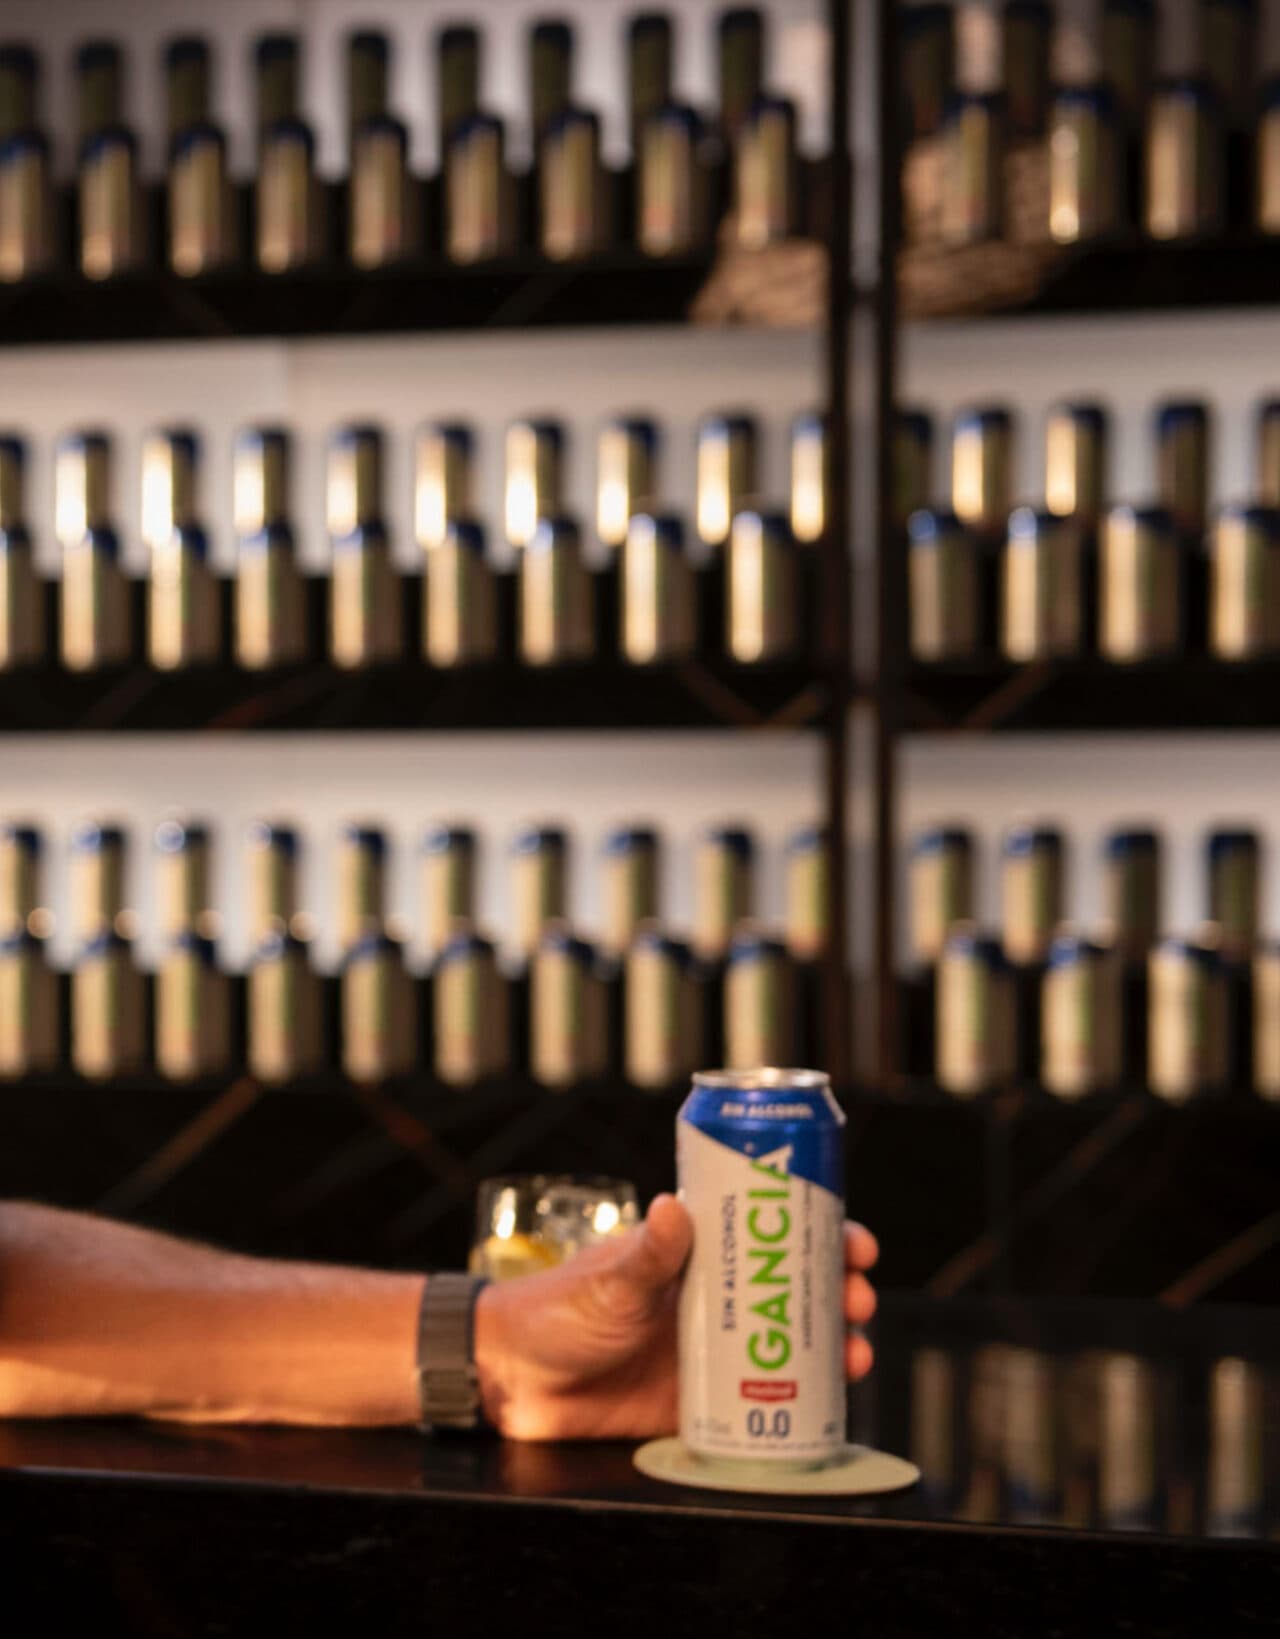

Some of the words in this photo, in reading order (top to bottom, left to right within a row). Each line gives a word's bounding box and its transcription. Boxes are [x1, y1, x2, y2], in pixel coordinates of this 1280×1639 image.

[748, 1103, 814, 1119] ALCOHOL
[722, 1194, 736, 1291] ALCOHOL
[747, 1144, 793, 1371] GANCIA
[722, 1298, 736, 1332] SIN
[747, 1408, 791, 1438] 0.0
